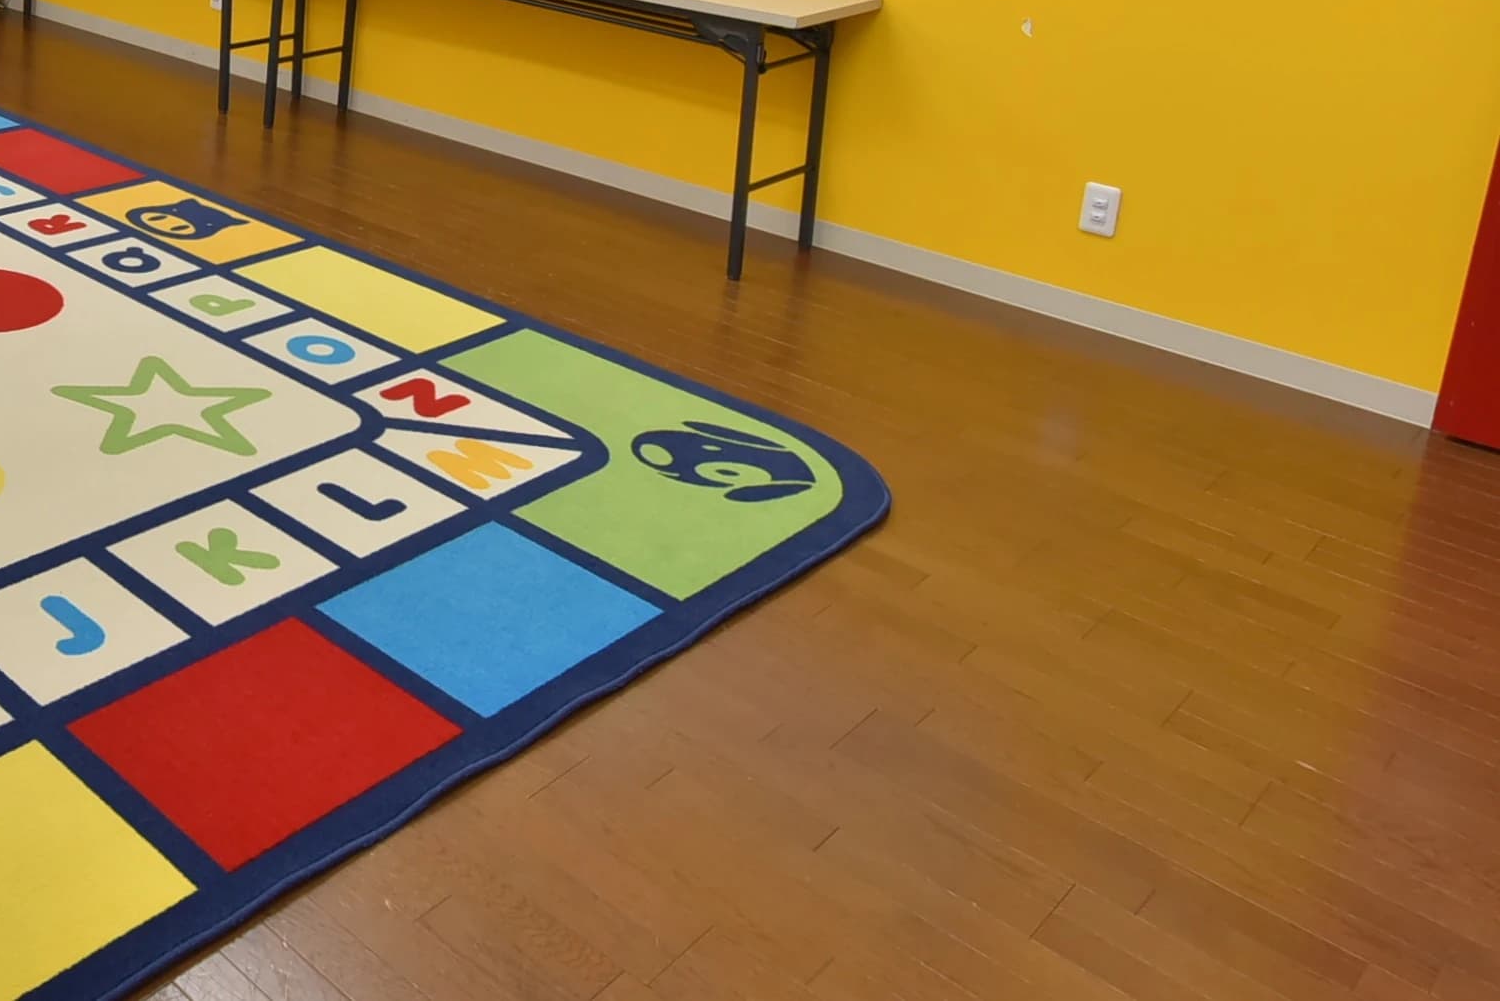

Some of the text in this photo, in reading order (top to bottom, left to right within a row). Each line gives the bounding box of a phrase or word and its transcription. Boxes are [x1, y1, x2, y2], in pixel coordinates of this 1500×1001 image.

[28, 214, 88, 236] R
[102, 247, 161, 273] Q
[191, 295, 255, 316] P
[287, 336, 355, 364] O
[41, 596, 105, 655] J
[176, 528, 280, 585] K
[317, 483, 407, 521] L
